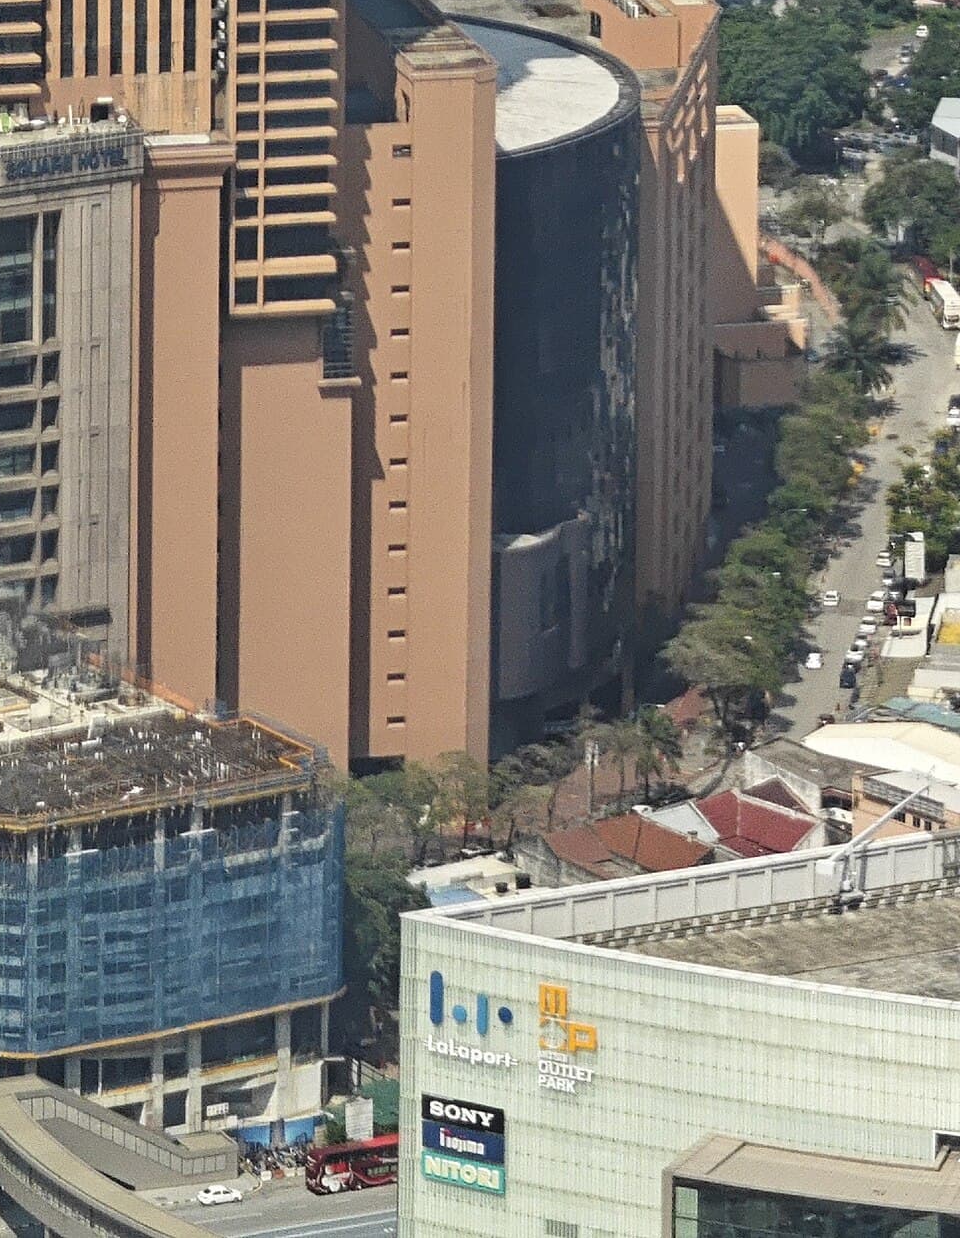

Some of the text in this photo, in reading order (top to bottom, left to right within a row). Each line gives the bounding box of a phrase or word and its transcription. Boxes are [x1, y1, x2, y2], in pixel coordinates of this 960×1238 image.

[539, 1060, 594, 1082] OUTLET
[539, 1074, 576, 1093] PARK
[429, 1100, 494, 1127] SONY
[424, 1154, 500, 1190] NITORI
